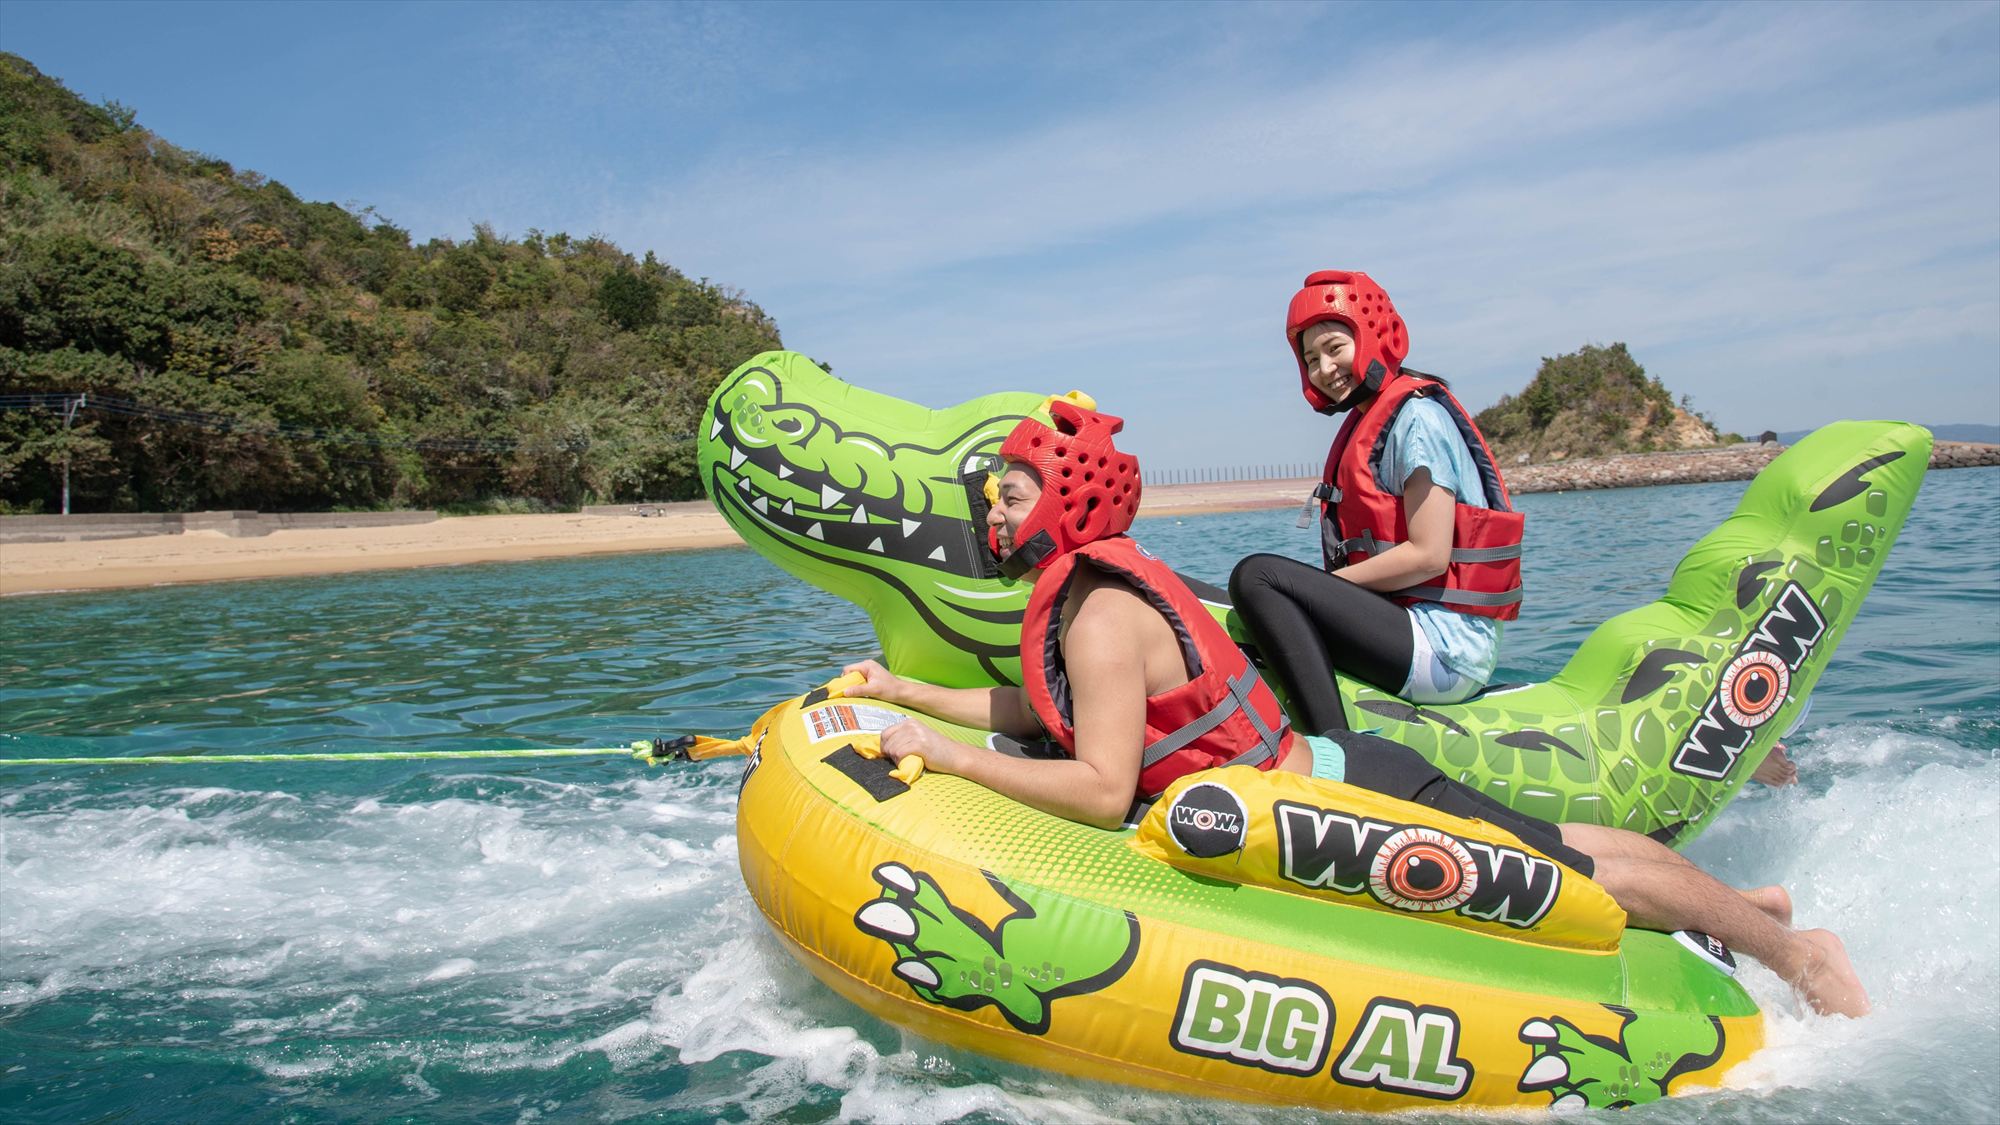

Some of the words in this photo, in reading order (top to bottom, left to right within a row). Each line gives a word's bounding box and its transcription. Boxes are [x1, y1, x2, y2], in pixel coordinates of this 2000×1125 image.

[1671, 581, 1827, 780] WOW
[1276, 802, 1561, 928] WOW
[1180, 971, 1326, 1069] BIG
[1342, 1008, 1465, 1092] AL
